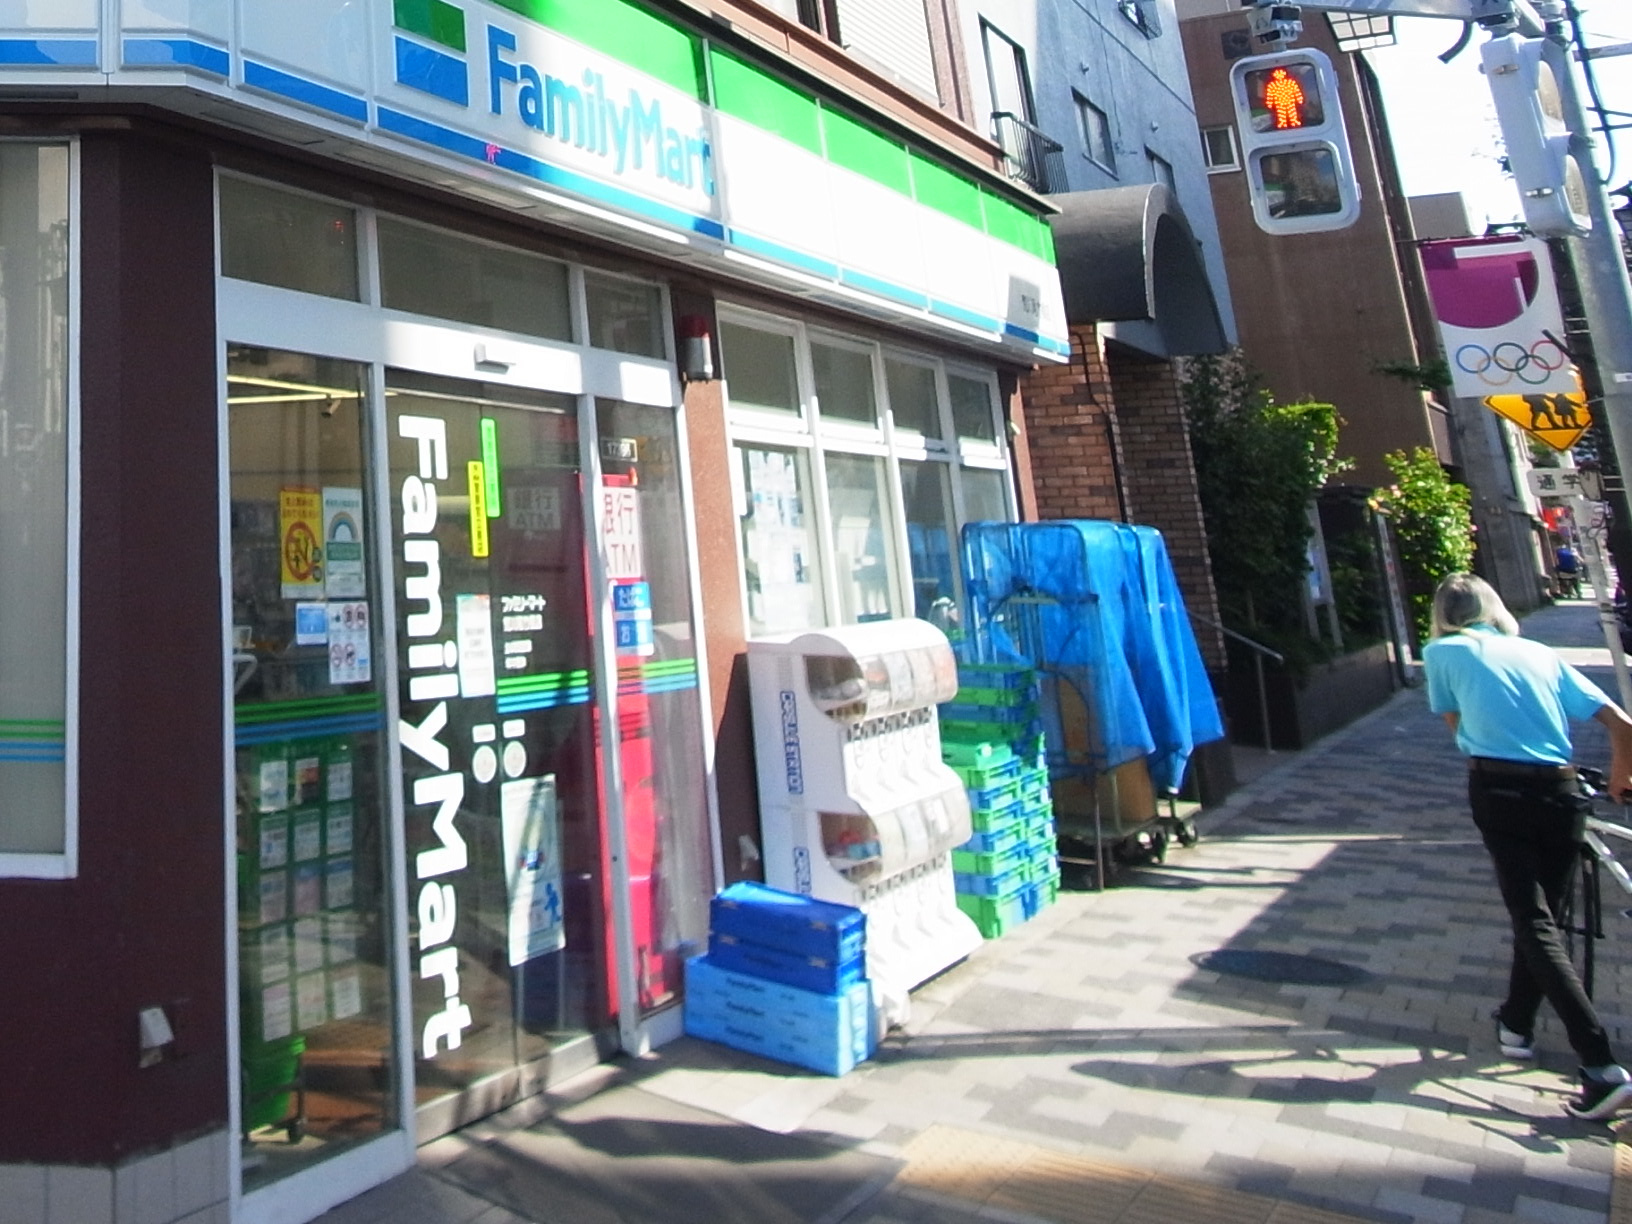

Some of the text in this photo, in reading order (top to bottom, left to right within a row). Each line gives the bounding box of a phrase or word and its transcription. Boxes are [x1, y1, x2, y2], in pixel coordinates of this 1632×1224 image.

[487, 23, 715, 197] FamilyMart
[607, 543, 638, 575] TM
[397, 414, 473, 1060] FamilyMart
